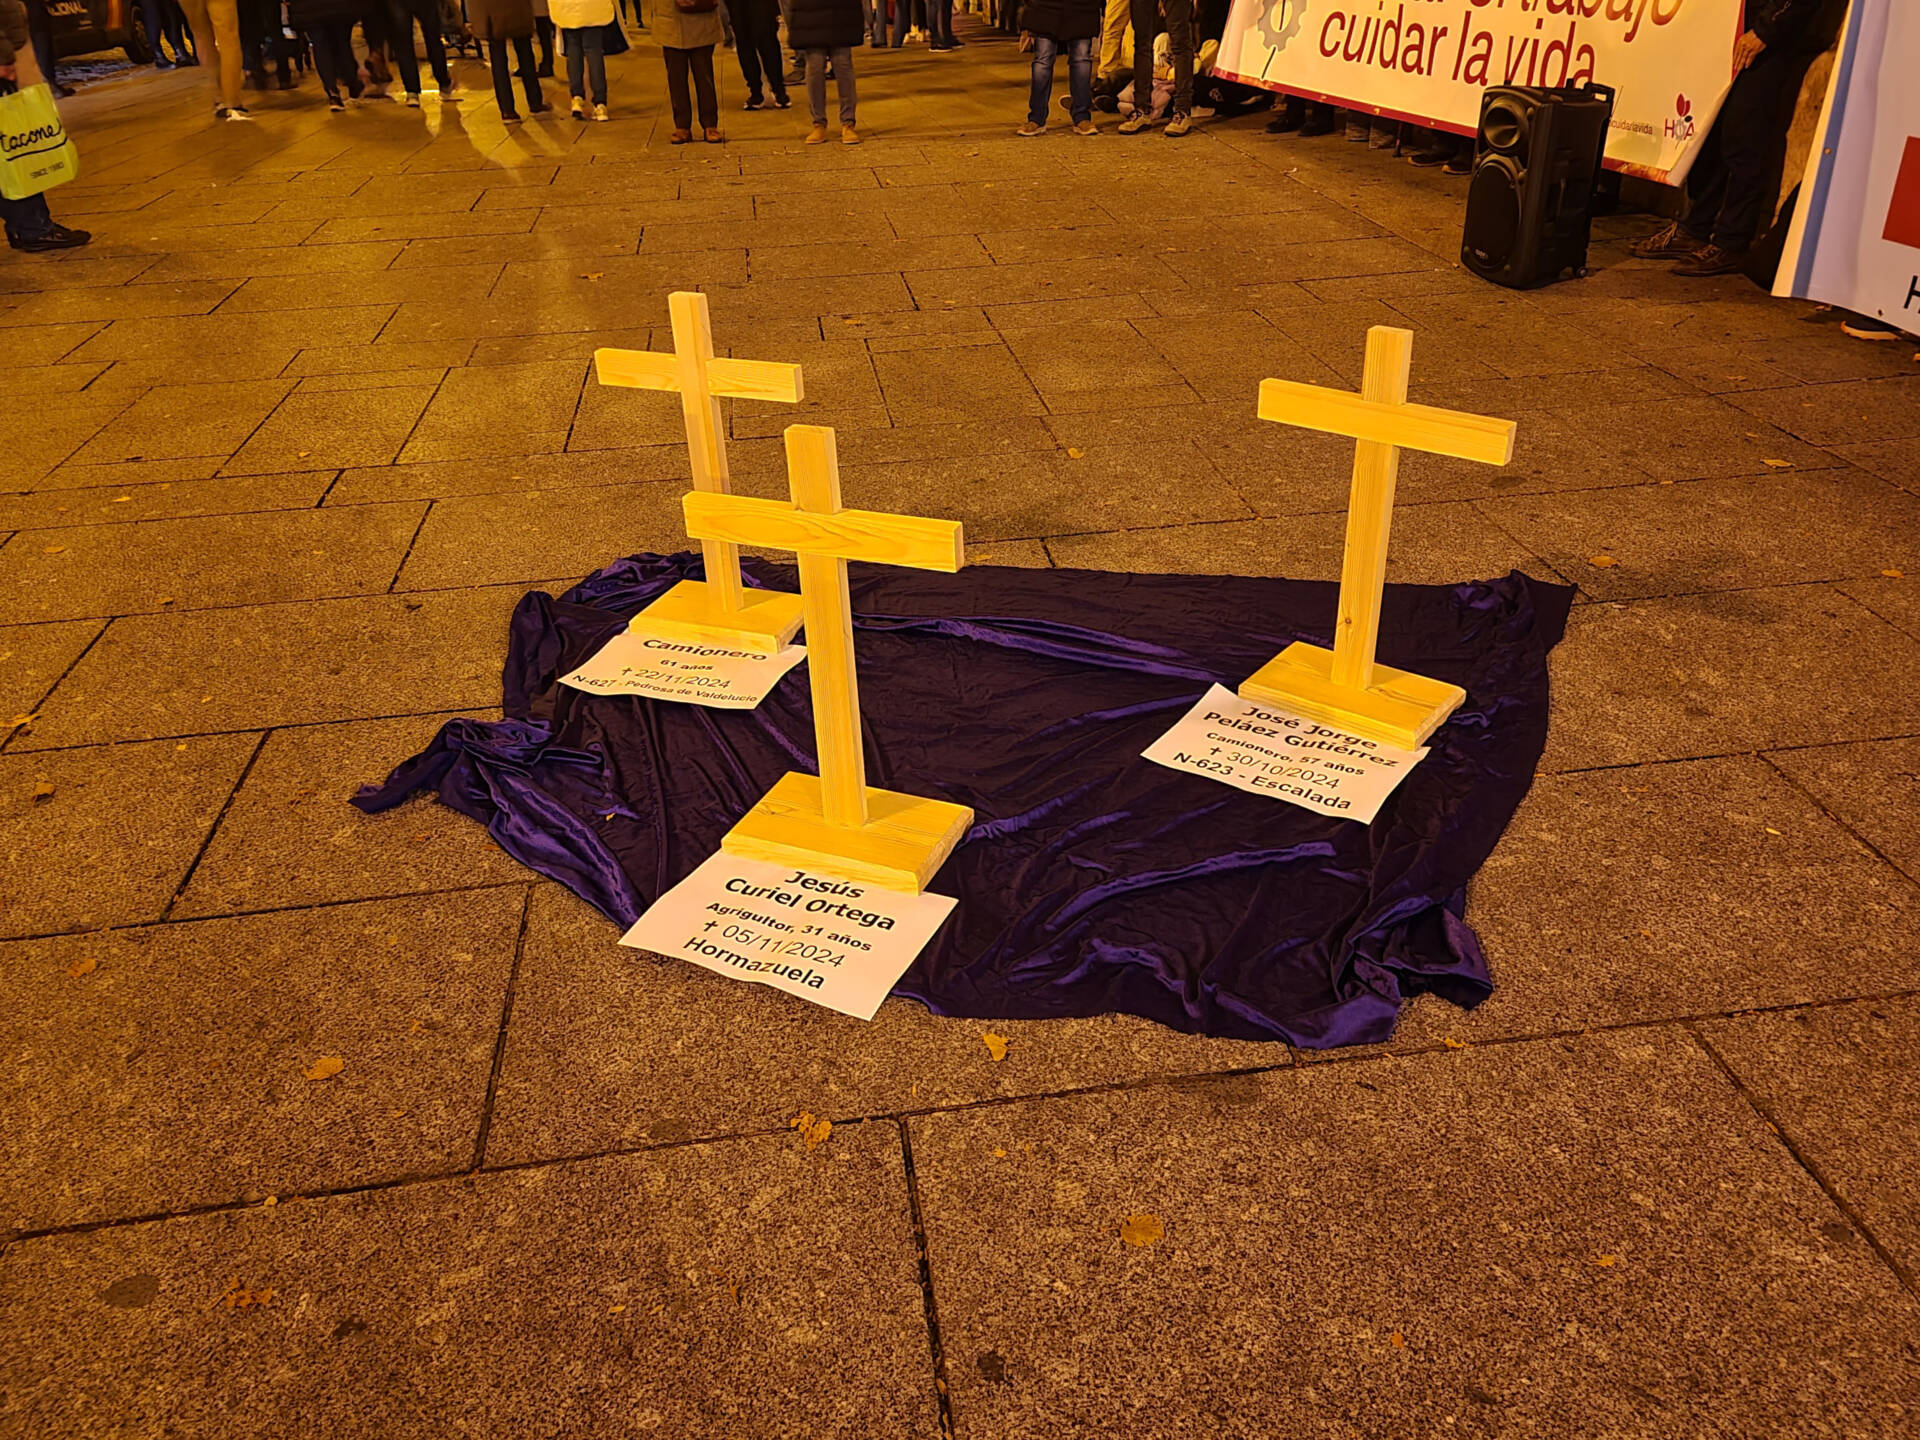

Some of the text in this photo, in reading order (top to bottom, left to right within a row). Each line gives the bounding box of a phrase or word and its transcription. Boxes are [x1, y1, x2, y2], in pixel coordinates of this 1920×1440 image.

[1320, 1, 1448, 76] cuidar
[1452, 10, 1494, 87] la
[1503, 18, 1596, 89] vida
[643, 639, 768, 661] Camionero
[660, 659, 678, 667] 61
[572, 675, 617, 688] N-627
[625, 680, 674, 695] Pedrosa
[696, 690, 758, 702] Valdelucio
[635, 668, 731, 690] 22/11/2024
[1203, 711, 1400, 768] Peláez Gutiérrez
[1243, 707, 1378, 750] José Jorge
[1206, 732, 1366, 776] Camionero, 57 años
[1227, 751, 1340, 789] 30/10/2024
[1173, 752, 1232, 776] N-623
[1250, 777, 1352, 810] Escalada
[724, 877, 896, 932] Curiel Ortega
[785, 870, 865, 900] Jesús
[706, 902, 873, 952] Agrigultor, 31 años
[722, 924, 845, 968] 05/11/2024
[683, 936, 826, 990] Hormazuela
